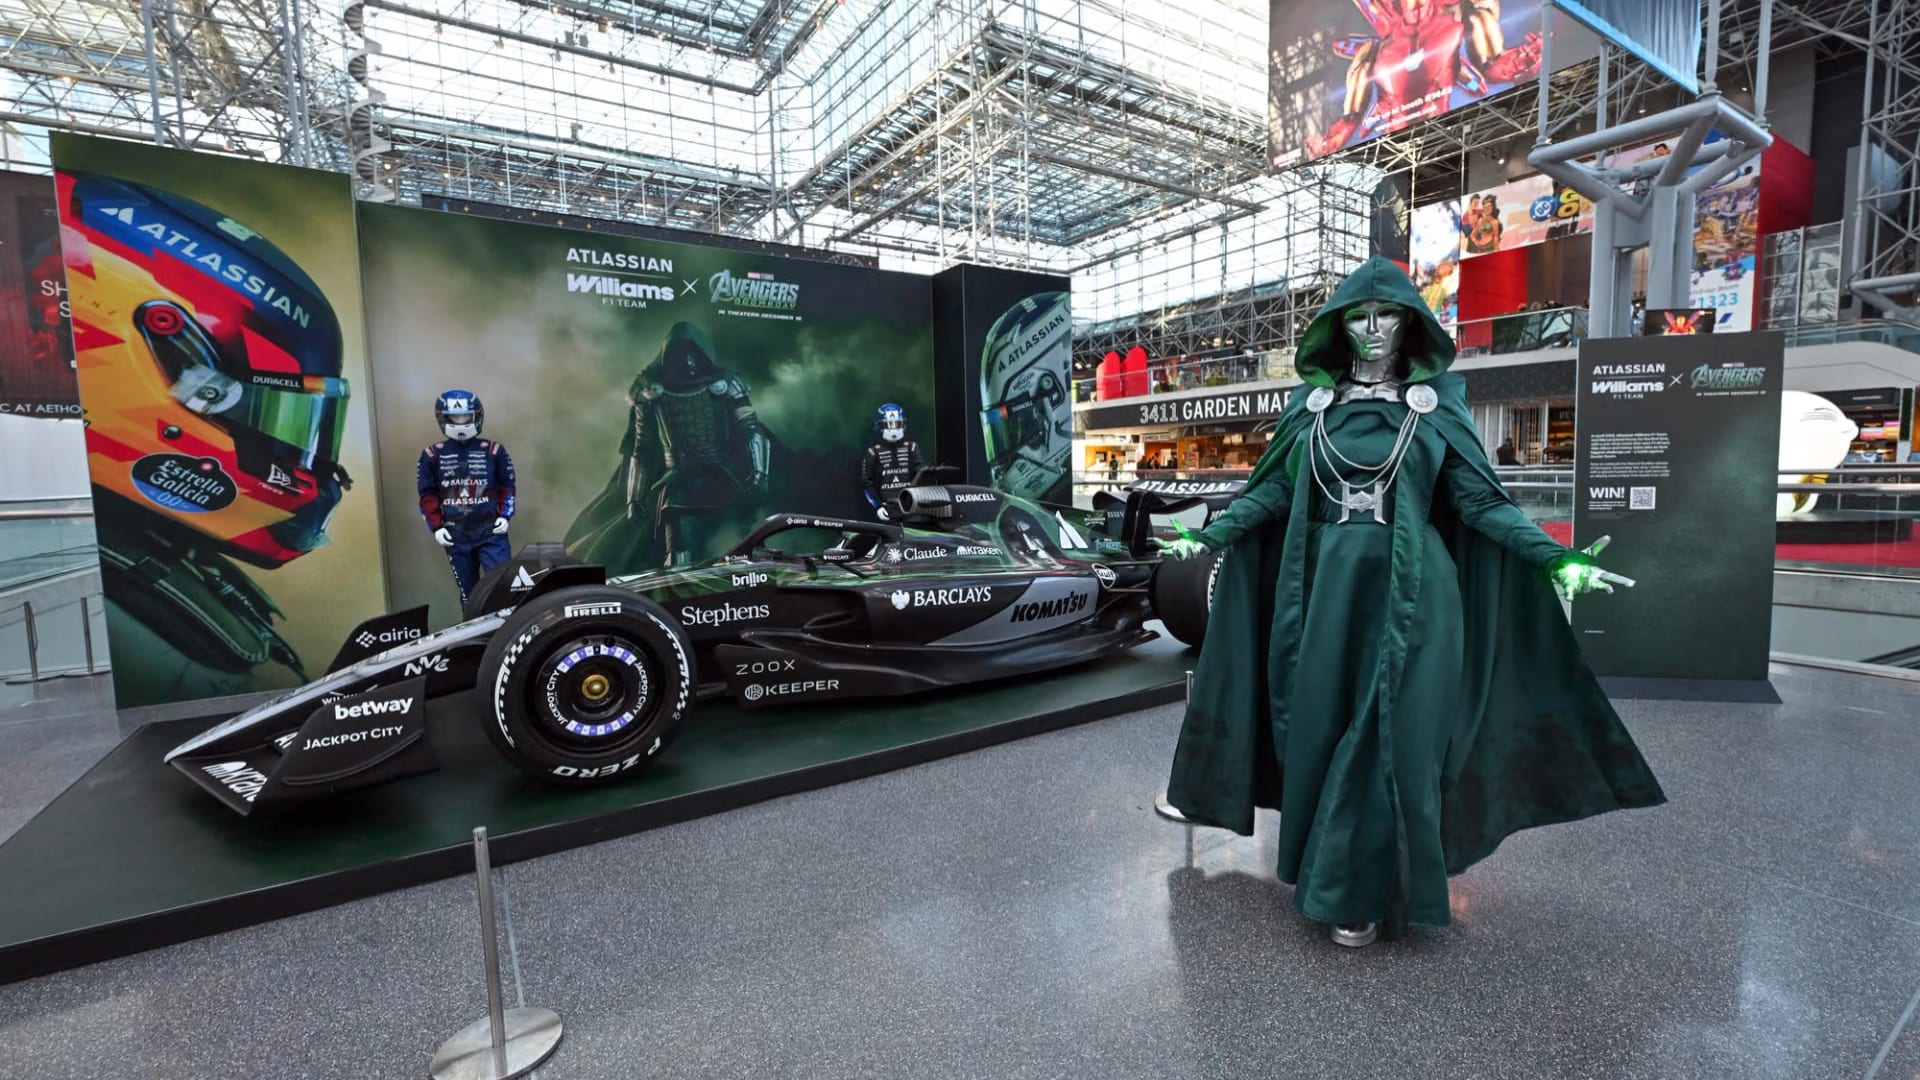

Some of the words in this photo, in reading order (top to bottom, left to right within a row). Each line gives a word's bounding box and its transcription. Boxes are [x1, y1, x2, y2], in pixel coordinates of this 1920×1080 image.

[566, 248, 673, 273] ATLASSIAN
[137, 222, 311, 329] ATLASSIAN
[709, 269, 800, 303] AVENGERS
[566, 273, 675, 301] Williams
[602, 298, 613, 307] F1
[618, 299, 647, 309] TEAM
[1007, 313, 1065, 368] ATLASSIAN
[1593, 363, 1665, 375] ATLASSIAN
[1690, 364, 1766, 389] AVENGERS
[252, 375, 301, 388] DURACELL
[1592, 380, 1665, 394] Williams
[14, 403, 33, 413] AT
[1139, 403, 1179, 425] 3411
[1183, 395, 1250, 420] GARDEN
[150, 471, 210, 505] Galicia
[158, 459, 225, 496] Estrella
[450, 478, 489, 486] BARCLAYS
[1137, 480, 1233, 495] ATLASSIAN
[443, 496, 489, 505] ATLASSIAN
[955, 493, 996, 503] DURACELL
[1589, 486, 1625, 499] WIN!
[903, 546, 948, 562] Claude
[914, 585, 992, 607] BARCLAYS
[564, 602, 622, 618] PIRELLI
[681, 602, 770, 627] Stephens
[1010, 590, 1089, 624] KOMATSU
[379, 627, 421, 643] airia
[735, 659, 796, 676] ZOOX
[547, 670, 560, 691] CITY
[634, 661, 648, 696] JACKPOT
[765, 679, 840, 696] KEEPER
[334, 697, 414, 721] betway
[547, 691, 569, 725] JACKPOT
[633, 696, 647, 715] CITY
[303, 731, 368, 751] JACKPOT
[370, 725, 404, 740] CITY
[647, 737, 661, 756] P
[552, 753, 641, 779] ZERO
